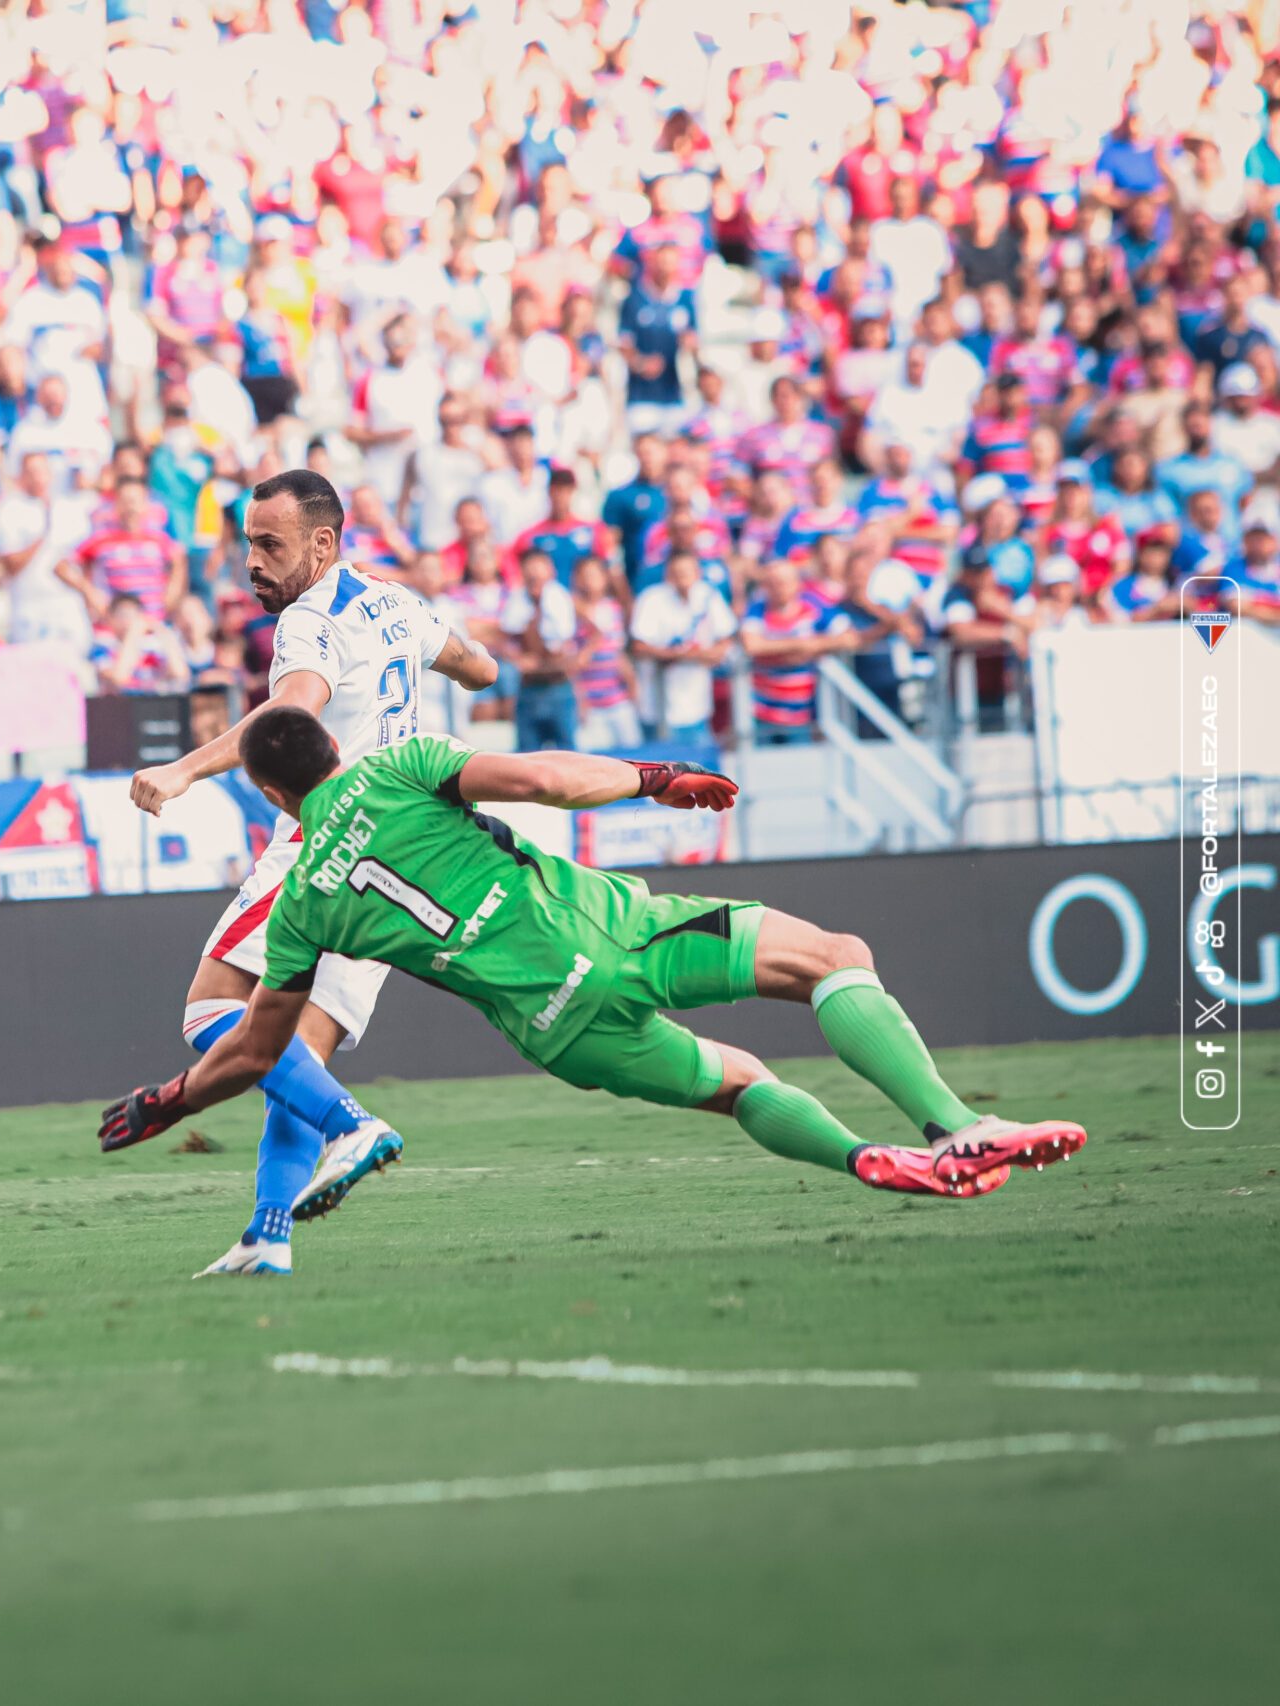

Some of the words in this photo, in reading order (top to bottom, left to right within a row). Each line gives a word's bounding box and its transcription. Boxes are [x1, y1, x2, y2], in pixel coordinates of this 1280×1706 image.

[309, 808, 377, 897] ROCHET
[346, 855, 461, 943] 1
[531, 952, 594, 1031] Unimed
